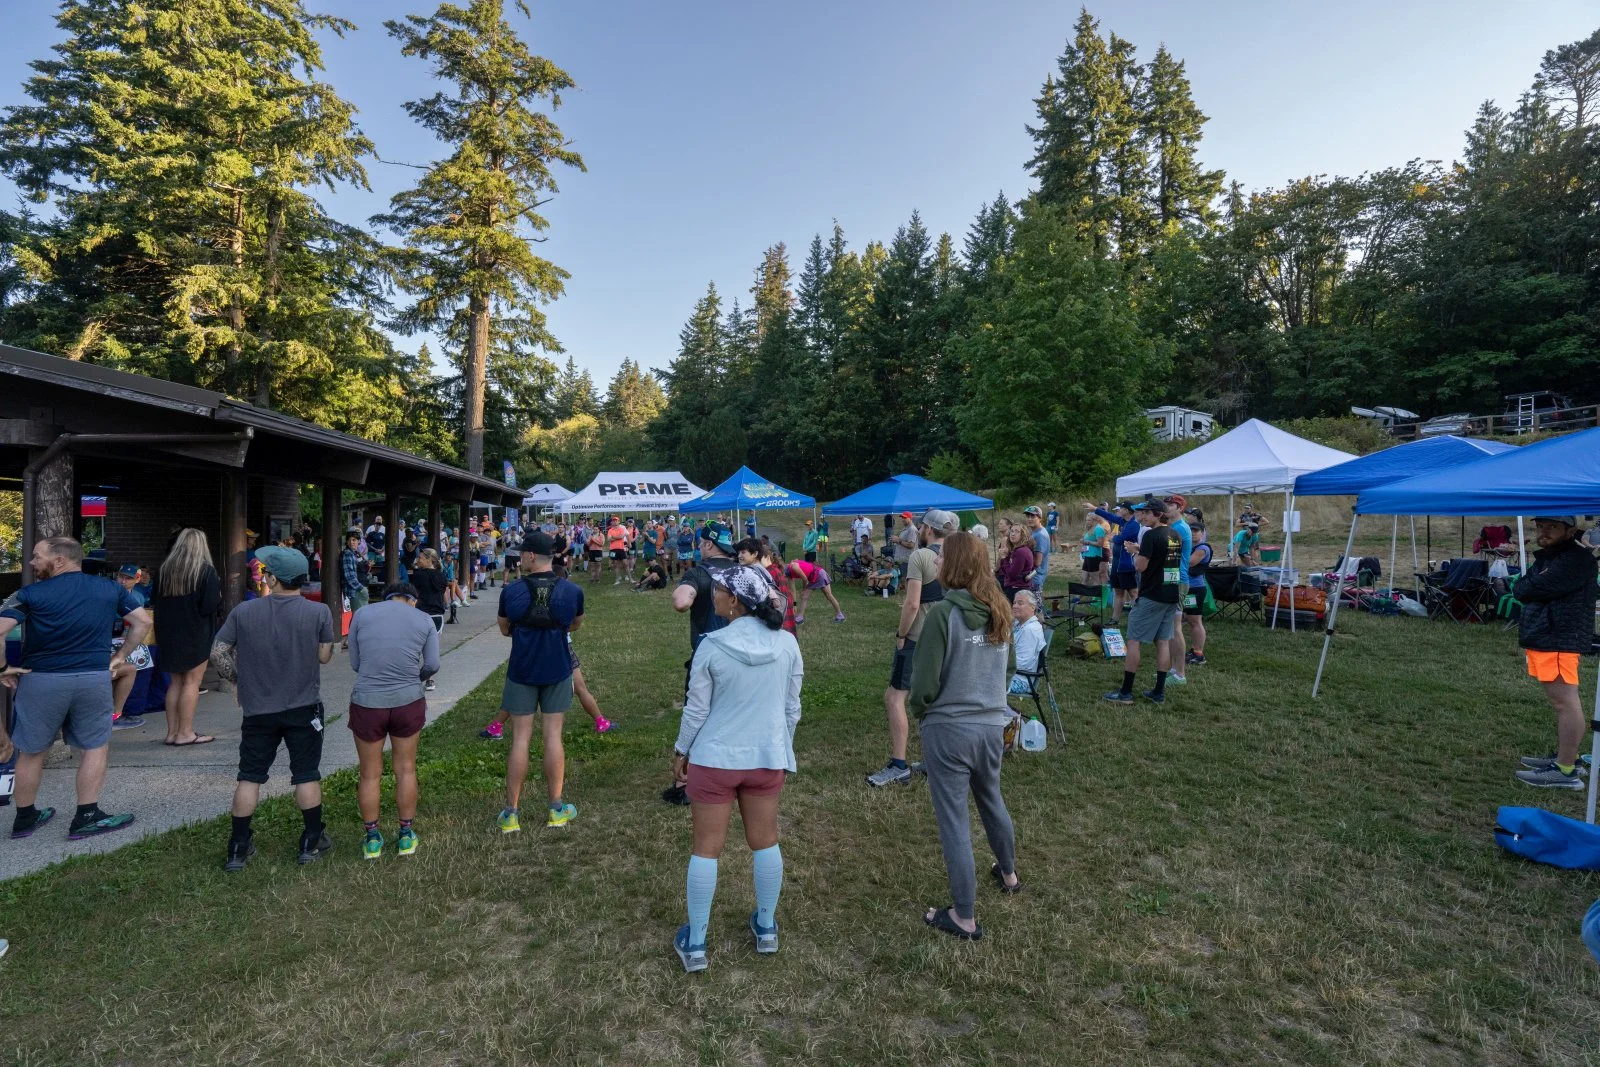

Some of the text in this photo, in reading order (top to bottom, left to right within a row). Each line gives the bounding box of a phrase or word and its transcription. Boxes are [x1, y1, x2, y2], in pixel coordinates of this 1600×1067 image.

[766, 499, 801, 507] BROOKS
[1169, 572, 1178, 580] 72
[972, 634, 984, 644] SKI
